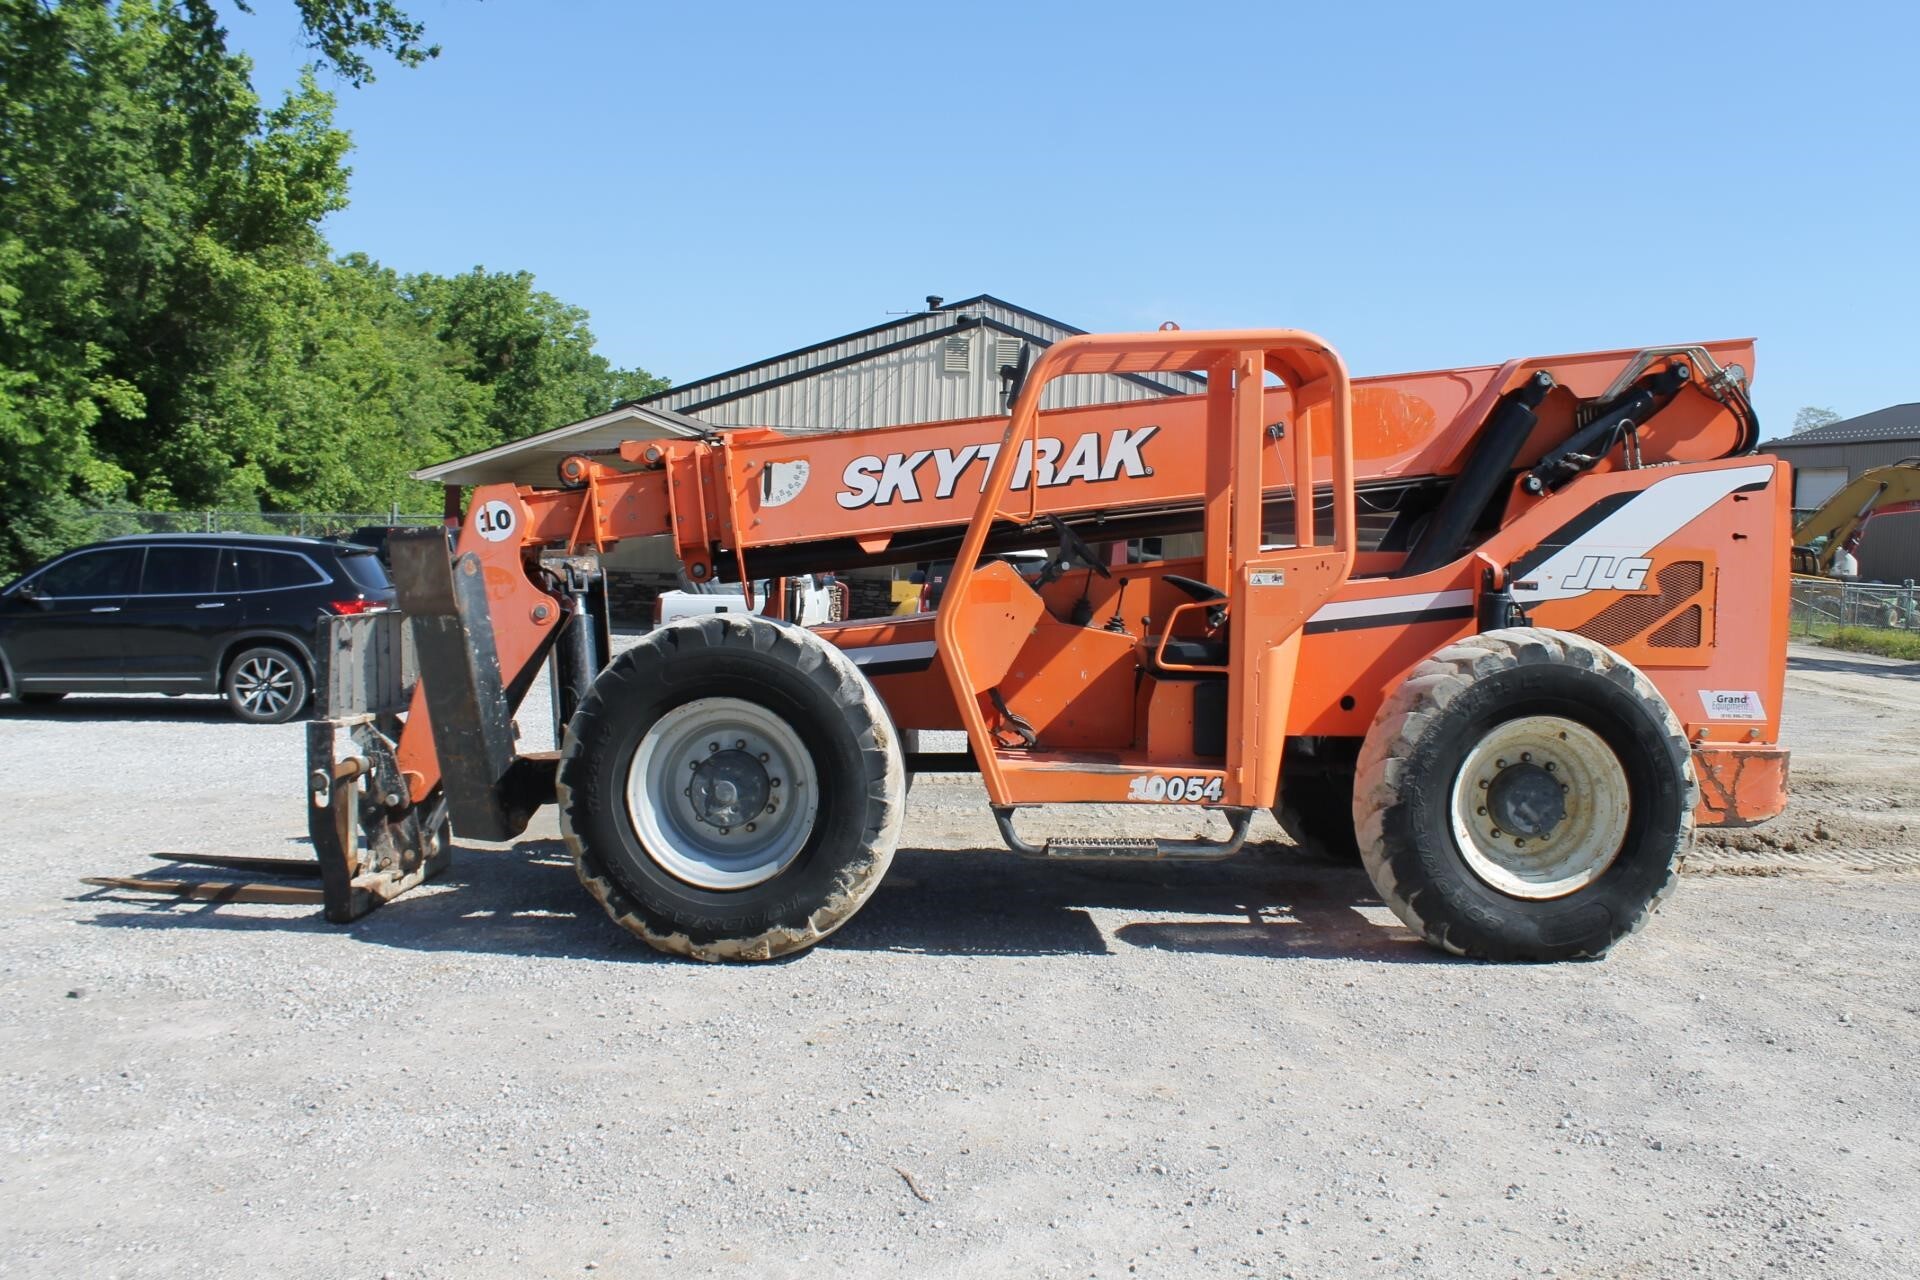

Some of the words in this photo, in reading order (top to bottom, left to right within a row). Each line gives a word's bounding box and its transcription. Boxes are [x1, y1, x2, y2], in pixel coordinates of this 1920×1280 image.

[480, 509, 511, 532] 10
[1560, 555, 1654, 591] JLG
[1716, 694, 1748, 704] Grand
